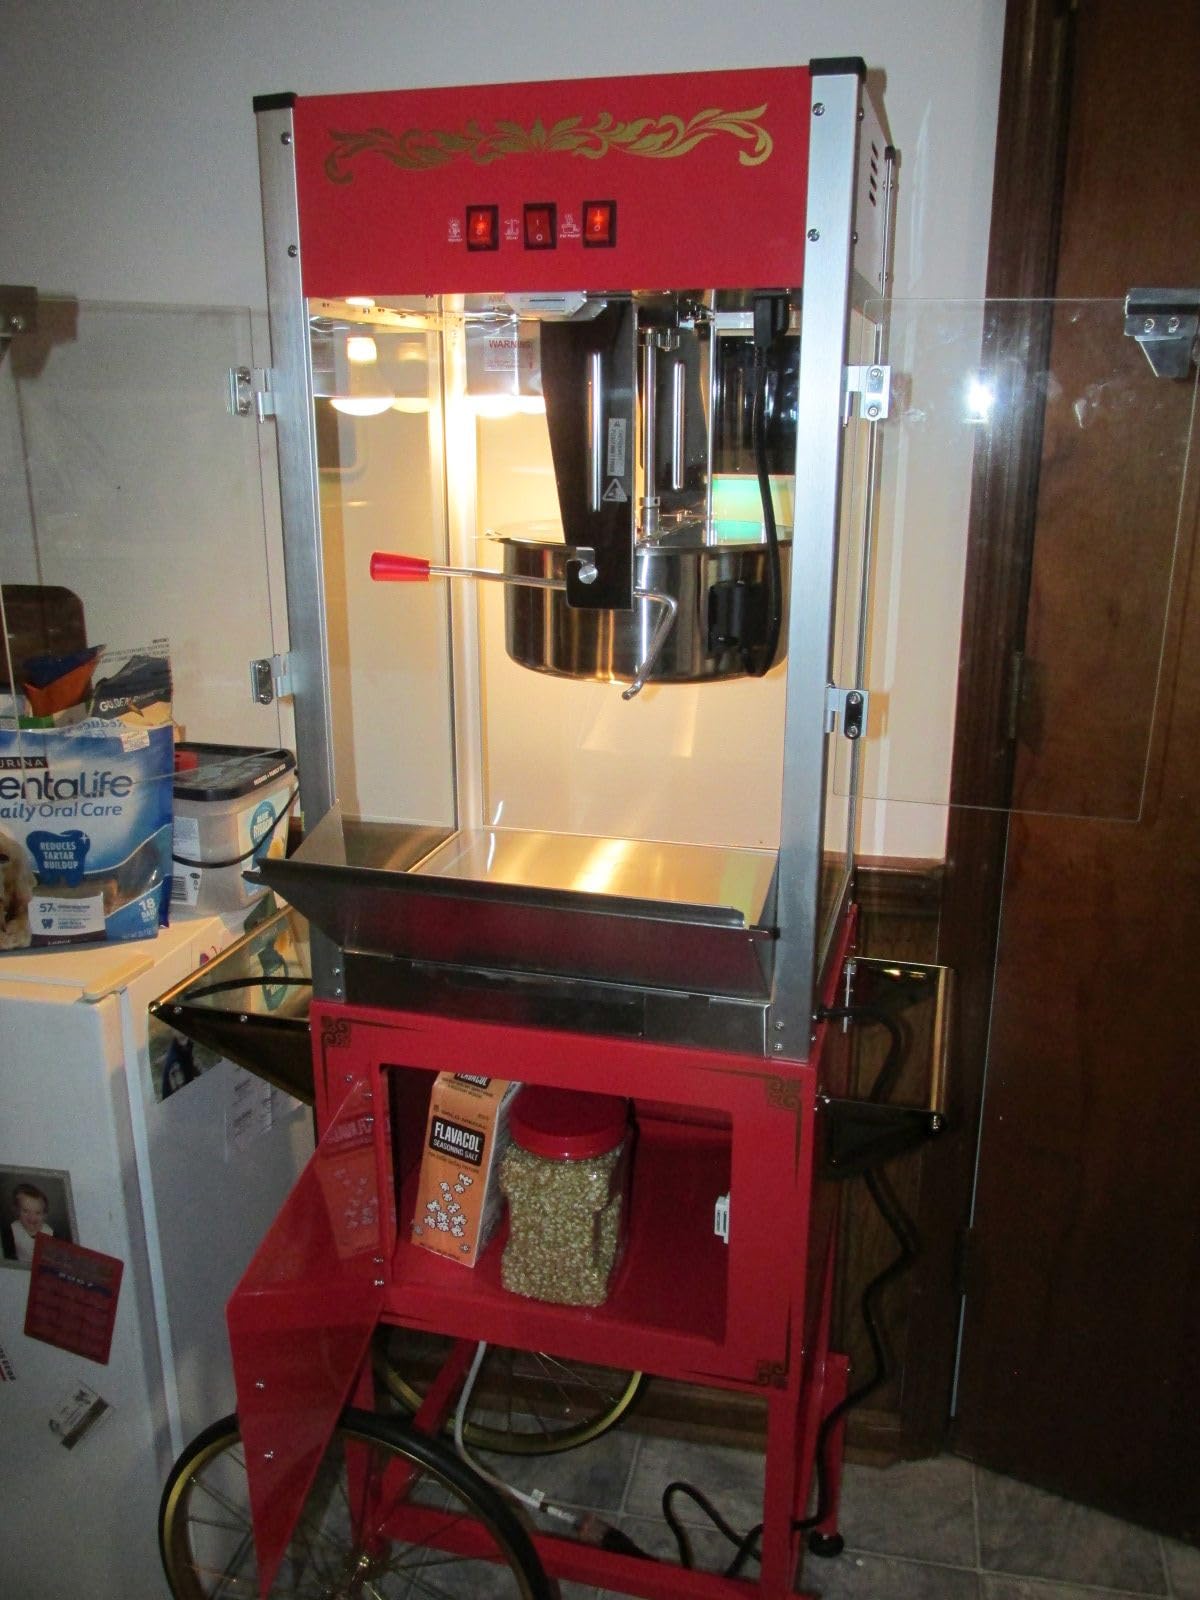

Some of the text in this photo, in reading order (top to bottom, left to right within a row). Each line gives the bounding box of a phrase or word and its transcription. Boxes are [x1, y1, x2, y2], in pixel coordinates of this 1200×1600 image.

[0, 758, 44, 768] URINA
[0, 771, 133, 800] entalife
[0, 802, 122, 822] aily Oral Care
[40, 841, 76, 850] REDUCES
[44, 851, 74, 859] TARTAR
[44, 861, 78, 869] BUILDUP
[434, 1121, 480, 1152] FLAVACOL
[433, 1139, 464, 1155] SEASONING
[464, 1151, 479, 1161] SALT
